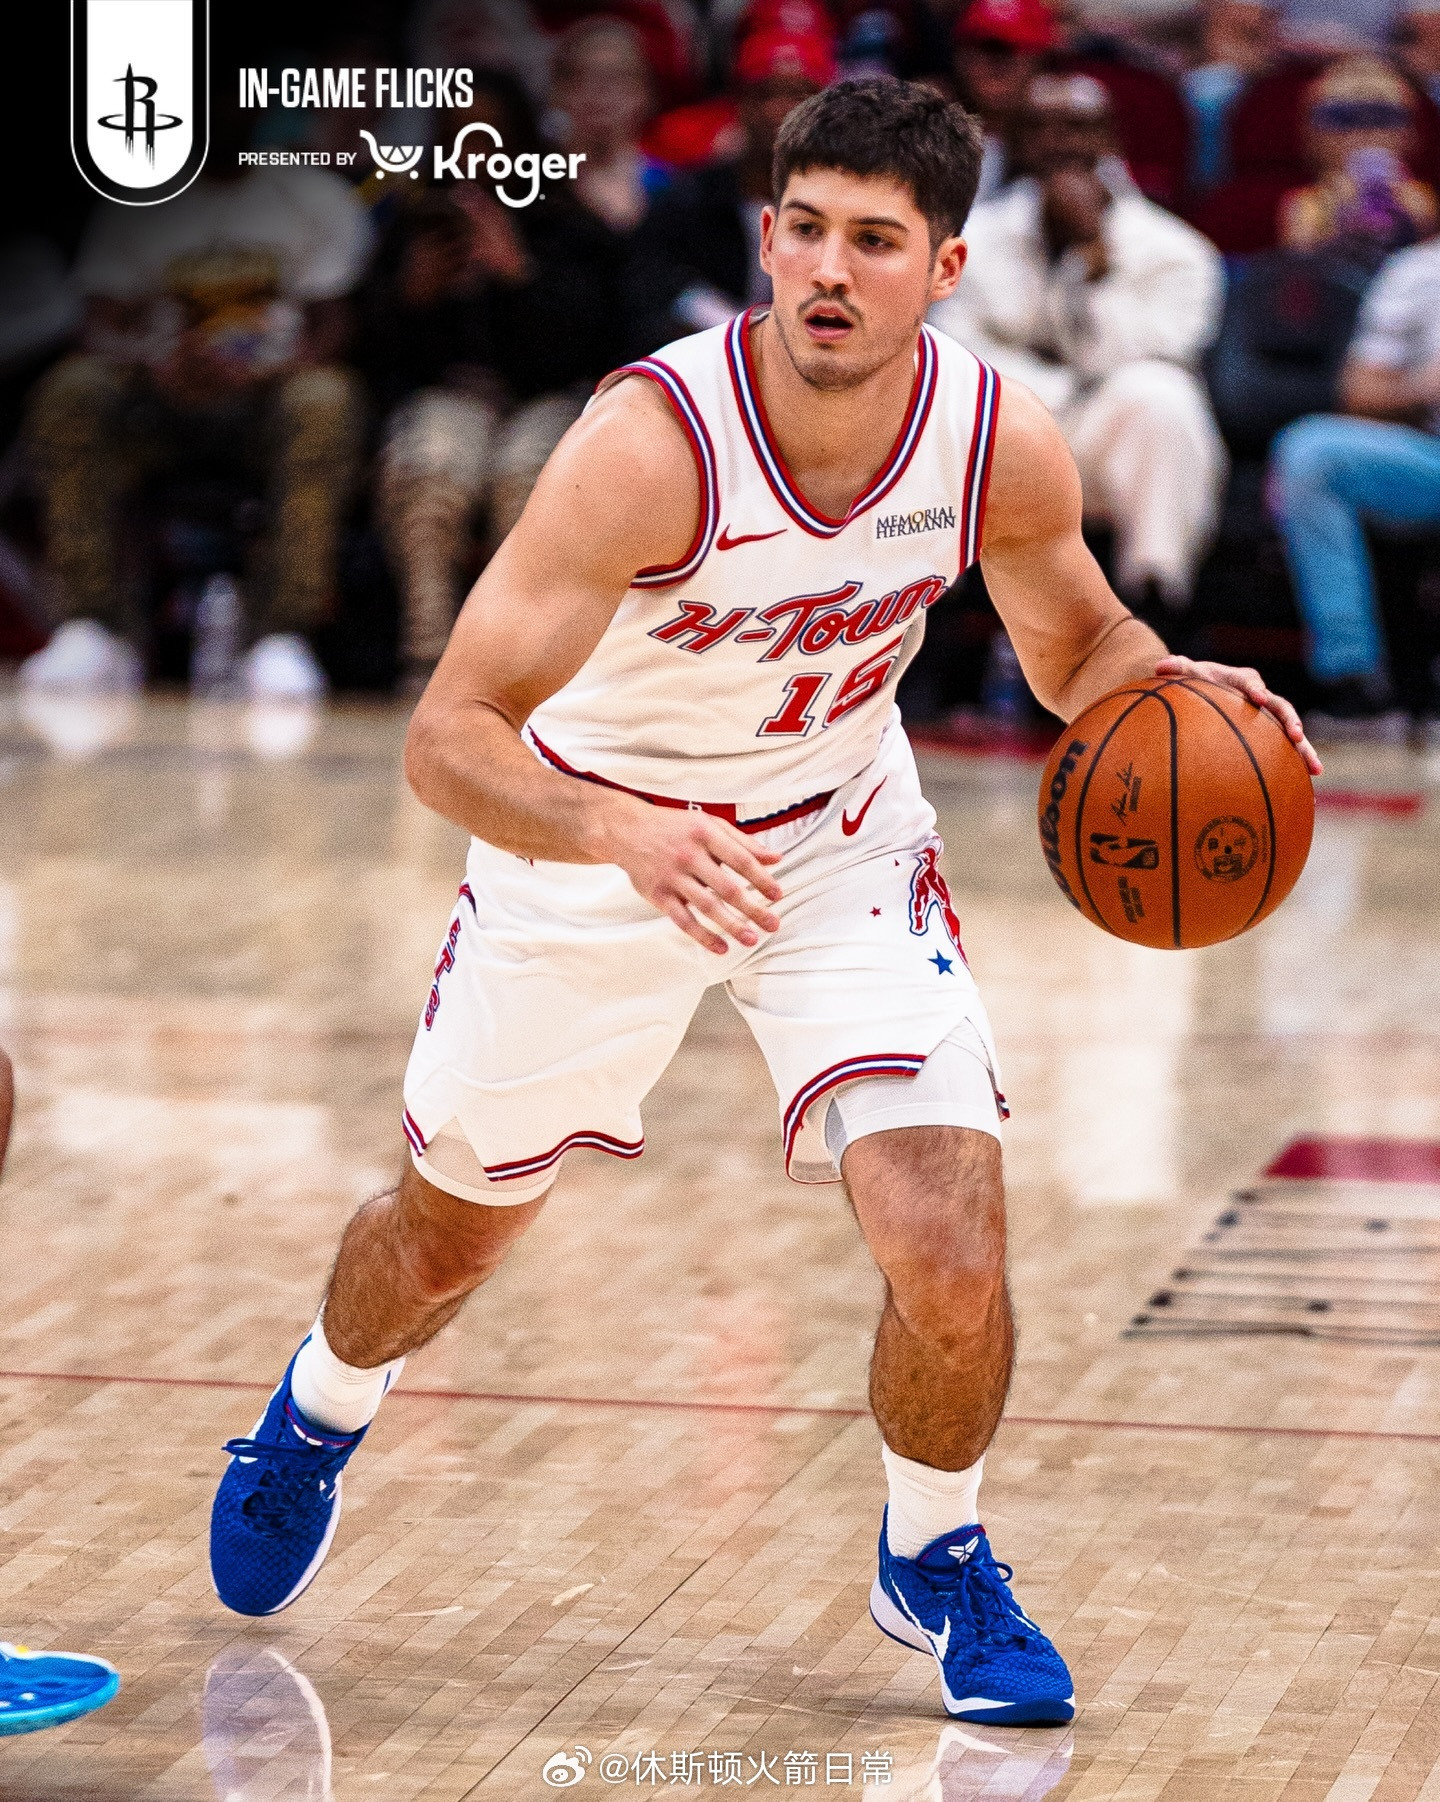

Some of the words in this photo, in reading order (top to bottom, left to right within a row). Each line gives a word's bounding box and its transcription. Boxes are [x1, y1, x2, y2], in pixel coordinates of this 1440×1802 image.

[876, 516, 955, 539] HERMANN
[877, 506, 956, 529] MEMORIAL
[646, 575, 950, 663] H-Town
